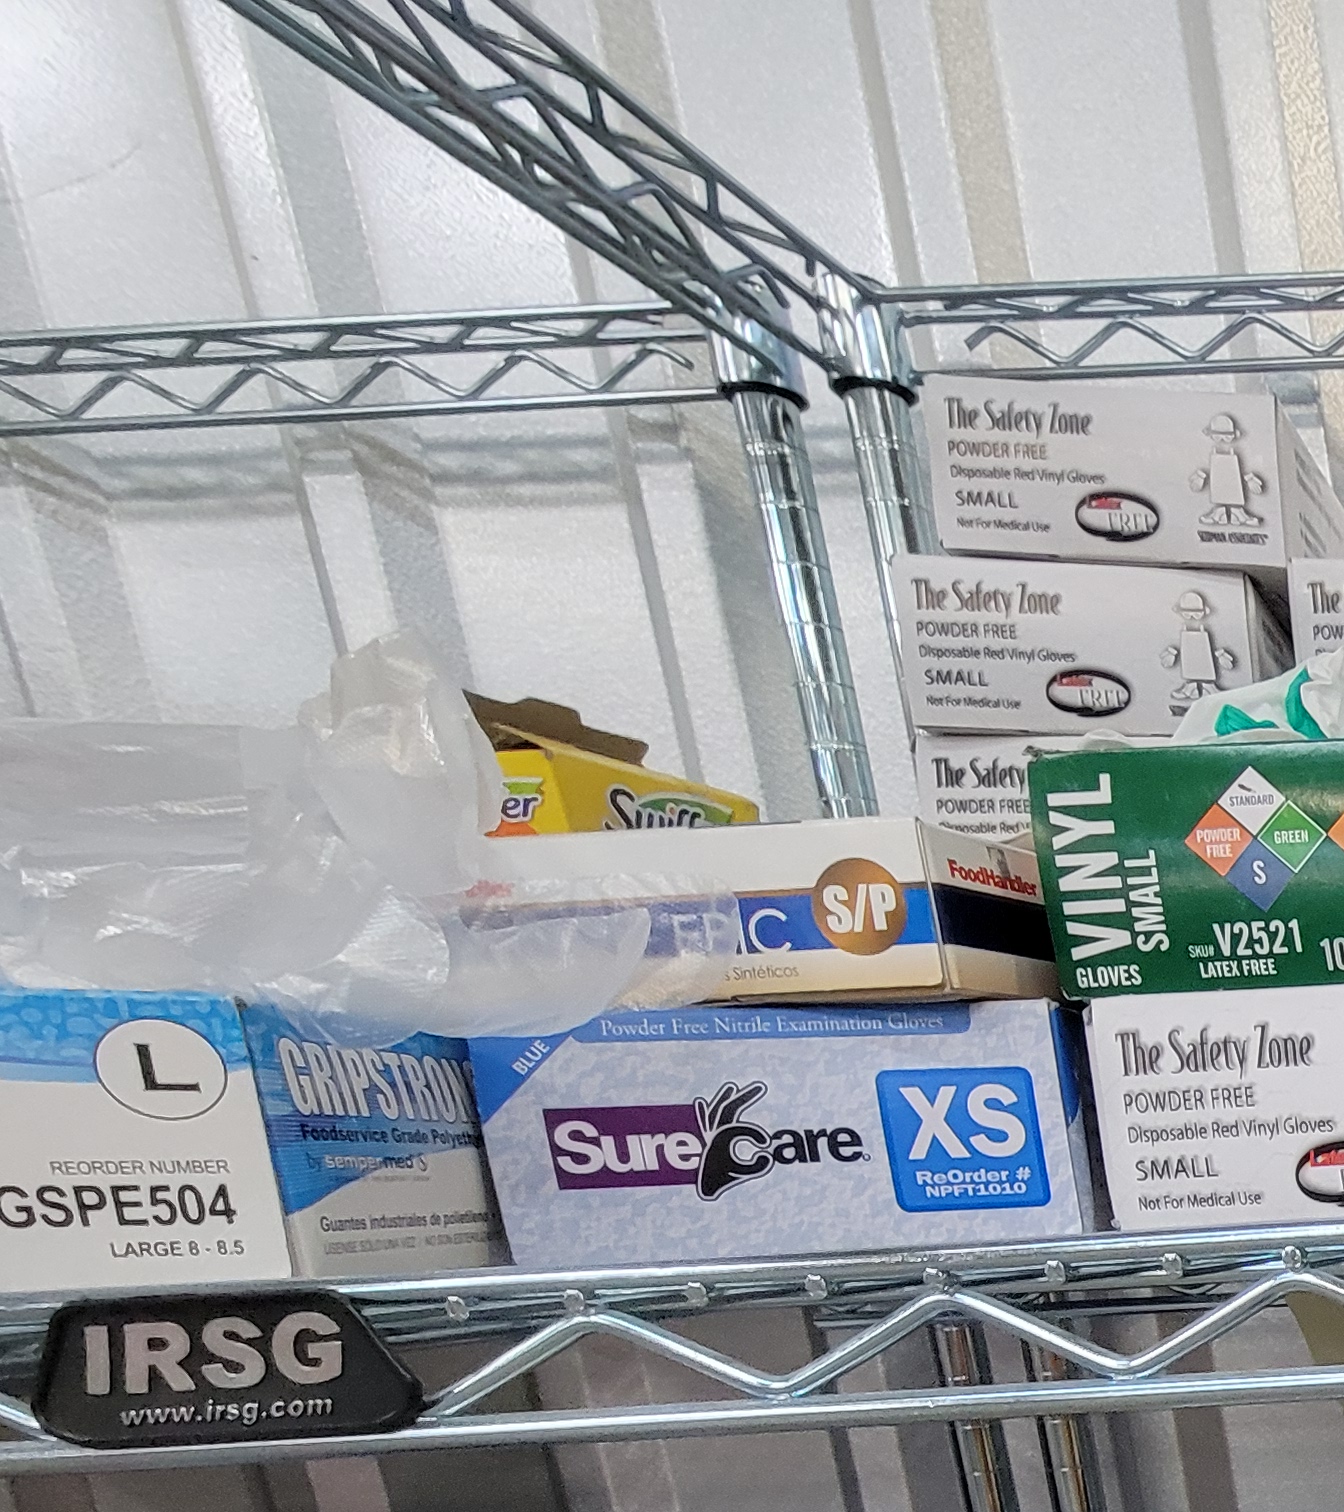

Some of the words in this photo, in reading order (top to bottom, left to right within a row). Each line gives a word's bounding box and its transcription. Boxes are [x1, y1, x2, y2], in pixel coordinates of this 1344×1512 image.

[946, 398, 980, 433] The
[985, 399, 1044, 439] Safety
[1049, 401, 1093, 437] Zone
[948, 441, 1008, 460] POWDER
[1013, 442, 1048, 461] FREE
[954, 489, 1018, 509] SMALL
[911, 579, 946, 611] The
[950, 580, 1011, 618] Safety
[1015, 582, 1062, 615] Zone
[1308, 575, 1342, 611] The
[916, 621, 977, 639] POWDER
[982, 622, 1017, 640] FREE
[924, 669, 989, 687] SMALL
[1229, 793, 1274, 807] STANDARD
[1197, 828, 1241, 843] POWDER
[1274, 829, 1309, 844] GREEN
[1206, 842, 1233, 858] FREE
[948, 859, 1038, 898] FoodHandler
[1047, 771, 1131, 961] VINYL
[1253, 861, 1266, 885] S
[821, 881, 897, 935] S/P
[1128, 849, 1170, 952] SMALL
[1188, 945, 1215, 958] SKU#
[1213, 919, 1303, 956] V2521
[1076, 965, 1142, 989] GLOVES
[1200, 961, 1240, 978] LATEX
[1244, 959, 1277, 976] FREE
[600, 1018, 665, 1039] Powder
[671, 1018, 707, 1036] Free
[714, 1015, 770, 1035] Nitrile
[777, 1014, 882, 1034] Examination
[887, 1012, 944, 1030] Gloves
[511, 1039, 550, 1077] BLUE
[1116, 1031, 1162, 1078] The
[1168, 1028, 1248, 1076] Safety
[1254, 1023, 1314, 1069] Zone
[133, 1042, 201, 1093] L
[1124, 1091, 1205, 1115] POWDER
[1211, 1088, 1255, 1108] FREE
[300, 1124, 388, 1142] Foodservice
[392, 1128, 428, 1144] Grade
[900, 1084, 1028, 1161] XS
[1127, 1123, 1207, 1145] Disposable
[1212, 1121, 1239, 1140] Red
[1243, 1118, 1279, 1140] Vinyl
[1283, 1116, 1334, 1134] Gloves
[50, 1161, 145, 1174] REORDER
[150, 1160, 230, 1174] NUMBER
[916, 1166, 1007, 1186] ReOrder
[1015, 1166, 1032, 1181] #
[1136, 1158, 1218, 1182] SMALL
[925, 1181, 1027, 1198] NPFT1010
[1139, 1197, 1160, 1210] Not
[1164, 1195, 1181, 1209] For
[1185, 1193, 1236, 1208] Medical
[1240, 1192, 1262, 1205] Use
[0, 1184, 237, 1228] GSPE504
[111, 1241, 184, 1258] LARGE
[188, 1241, 200, 1256] 8
[217, 1241, 244, 1256] 8.5
[84, 1312, 342, 1397] IRSG
[121, 1398, 333, 1426] www.irsg.com
